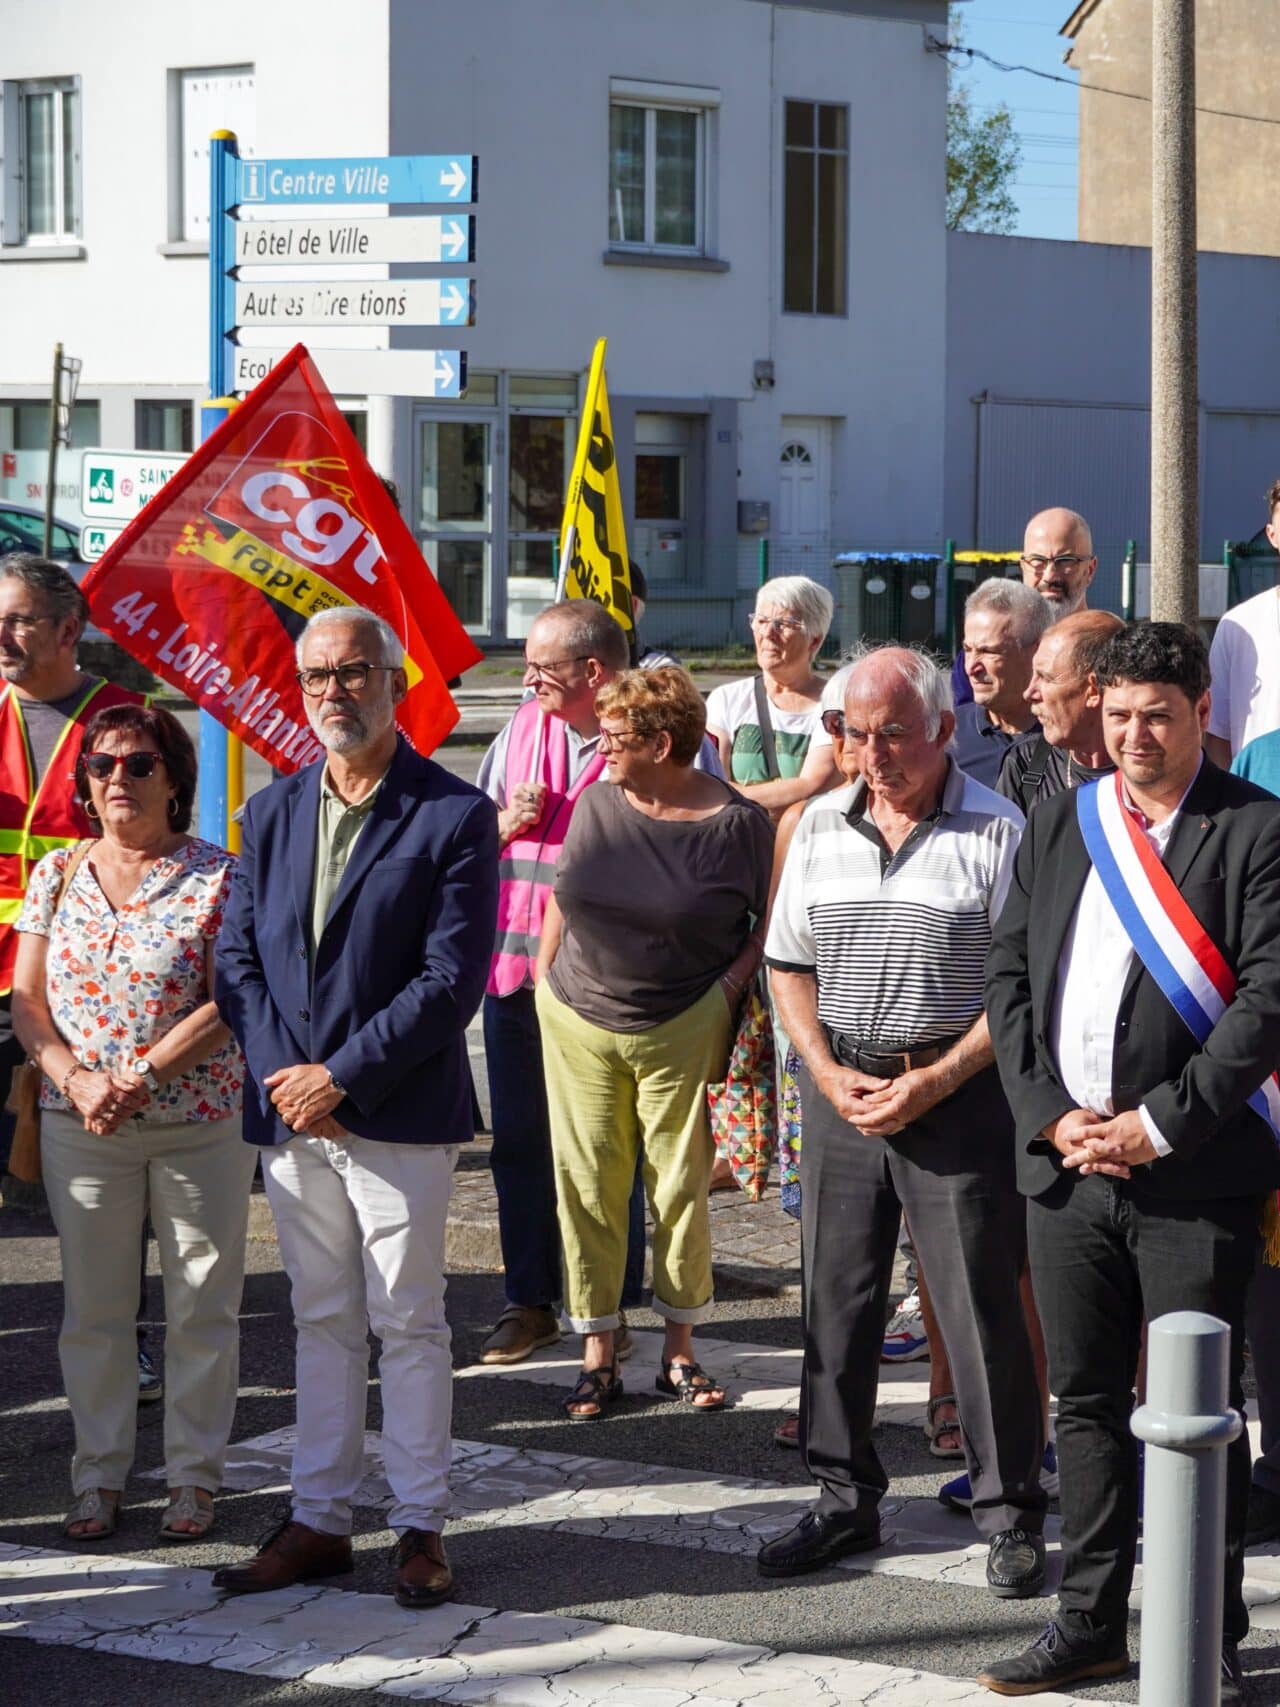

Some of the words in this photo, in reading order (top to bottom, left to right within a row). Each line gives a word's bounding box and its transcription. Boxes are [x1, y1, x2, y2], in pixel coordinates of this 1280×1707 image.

[269, 169, 336, 196] Centre
[343, 166, 390, 195] Ville
[242, 229, 293, 256] Hôtel
[298, 228, 321, 255] de
[329, 227, 369, 254] Ville
[243, 291, 305, 316] Autes
[239, 357, 274, 379] Ecol
[241, 471, 388, 585] cgt
[232, 544, 313, 600] fapt
[112, 591, 158, 637] 44
